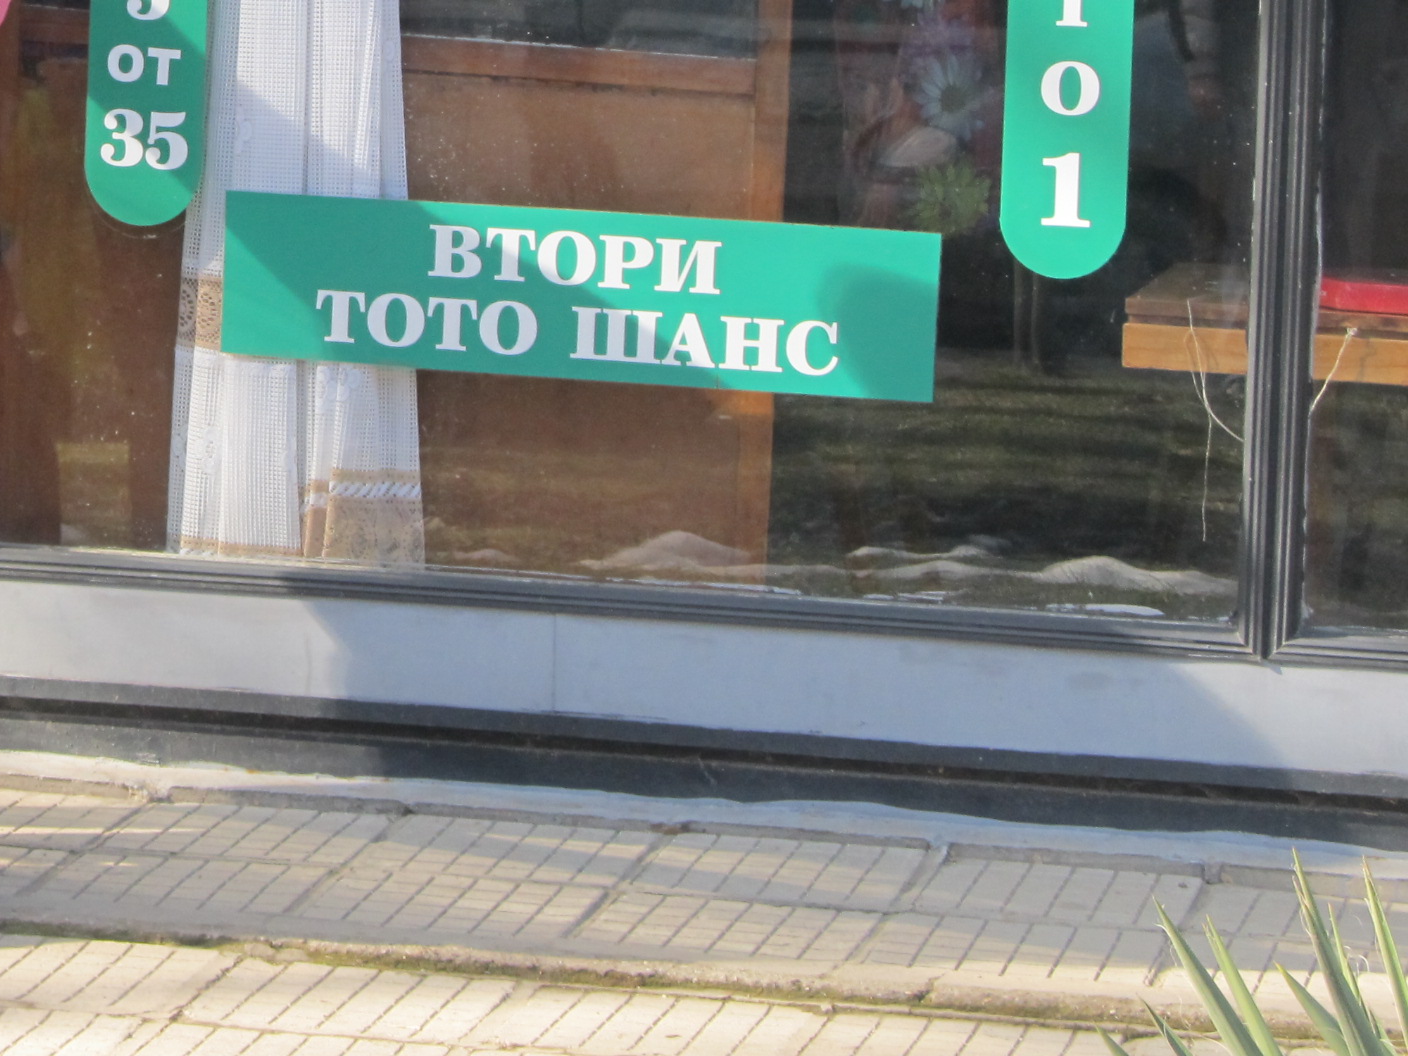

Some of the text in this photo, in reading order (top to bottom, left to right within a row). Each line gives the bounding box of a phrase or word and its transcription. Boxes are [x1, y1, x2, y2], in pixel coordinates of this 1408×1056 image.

[100, 108, 189, 171] 35
[428, 224, 723, 296] ВТОРИ
[316, 289, 839, 377] ТОТО ШАНС
